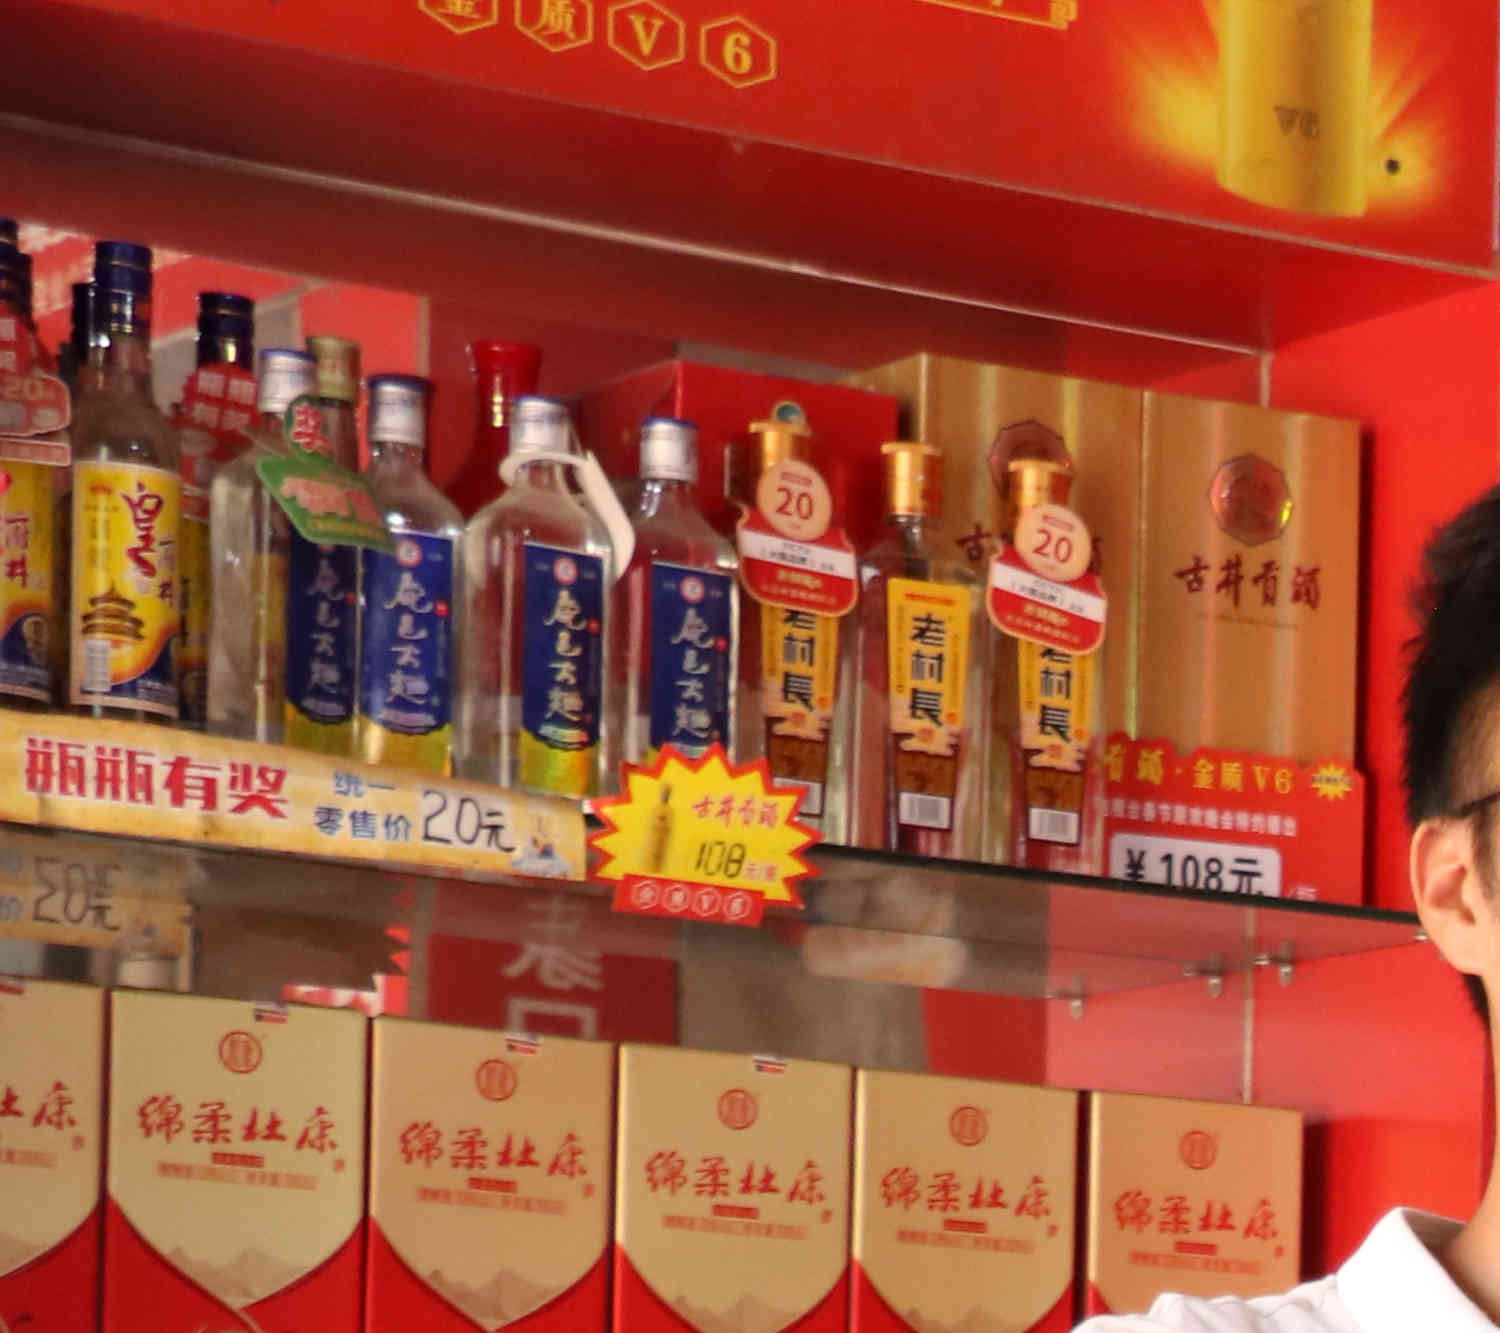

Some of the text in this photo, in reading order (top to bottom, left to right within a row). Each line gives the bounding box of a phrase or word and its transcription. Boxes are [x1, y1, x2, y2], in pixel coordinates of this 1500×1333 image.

[775, 488, 815, 524] 20
[1033, 527, 1074, 561] 20
[24, 734, 291, 820] 瓶瓶有奖
[332, 770, 398, 798] 统一
[313, 805, 413, 844] 零售价
[1160, 853, 1263, 896] 108元
